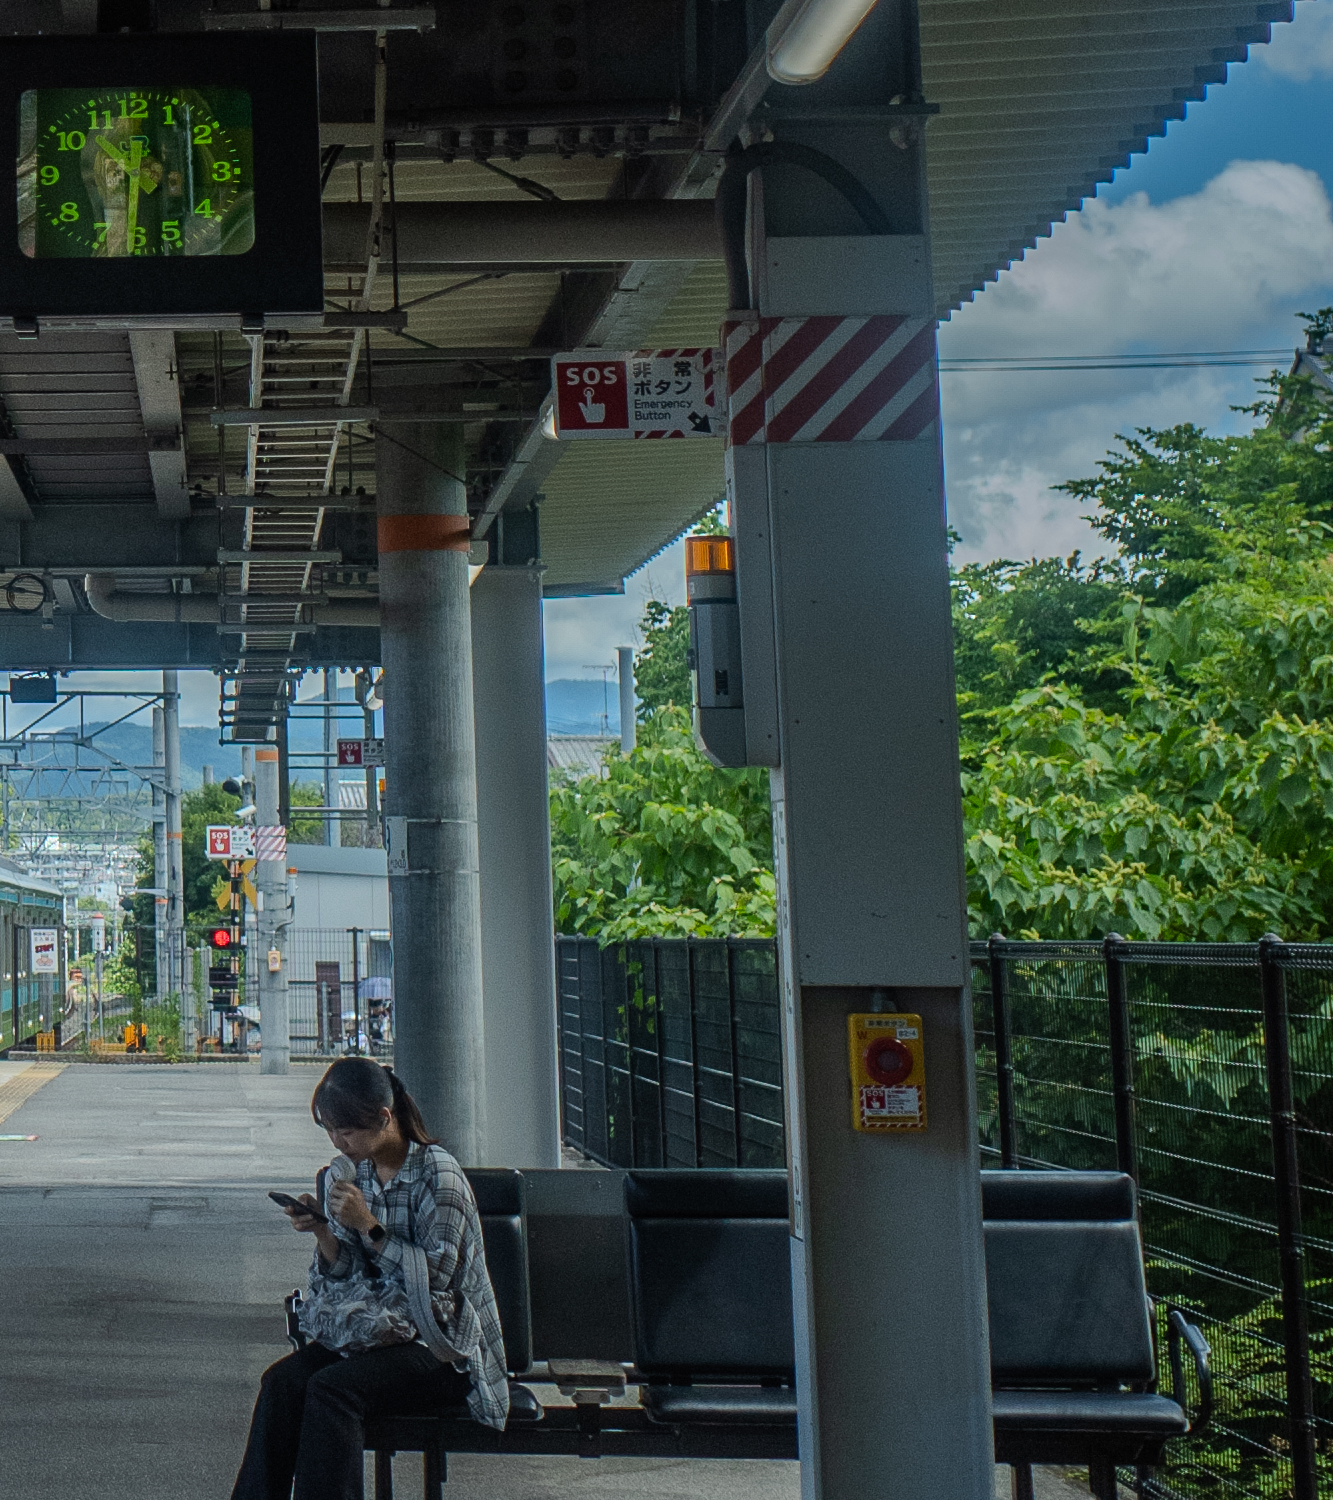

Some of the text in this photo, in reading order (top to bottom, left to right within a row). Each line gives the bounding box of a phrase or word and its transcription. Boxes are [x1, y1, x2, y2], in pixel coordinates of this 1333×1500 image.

[87, 105, 175, 130] 11 1
[118, 99, 149, 119] 12
[56, 124, 213, 151] 10 2
[40, 161, 231, 186] 9 3
[59, 198, 215, 222] 8 4
[93, 220, 180, 247] 7 6 5
[566, 367, 618, 386] SOS
[634, 379, 692, 396] ボタン
[634, 399, 693, 411] Emergency
[635, 410, 671, 421] Button
[211, 831, 229, 839] SOS
